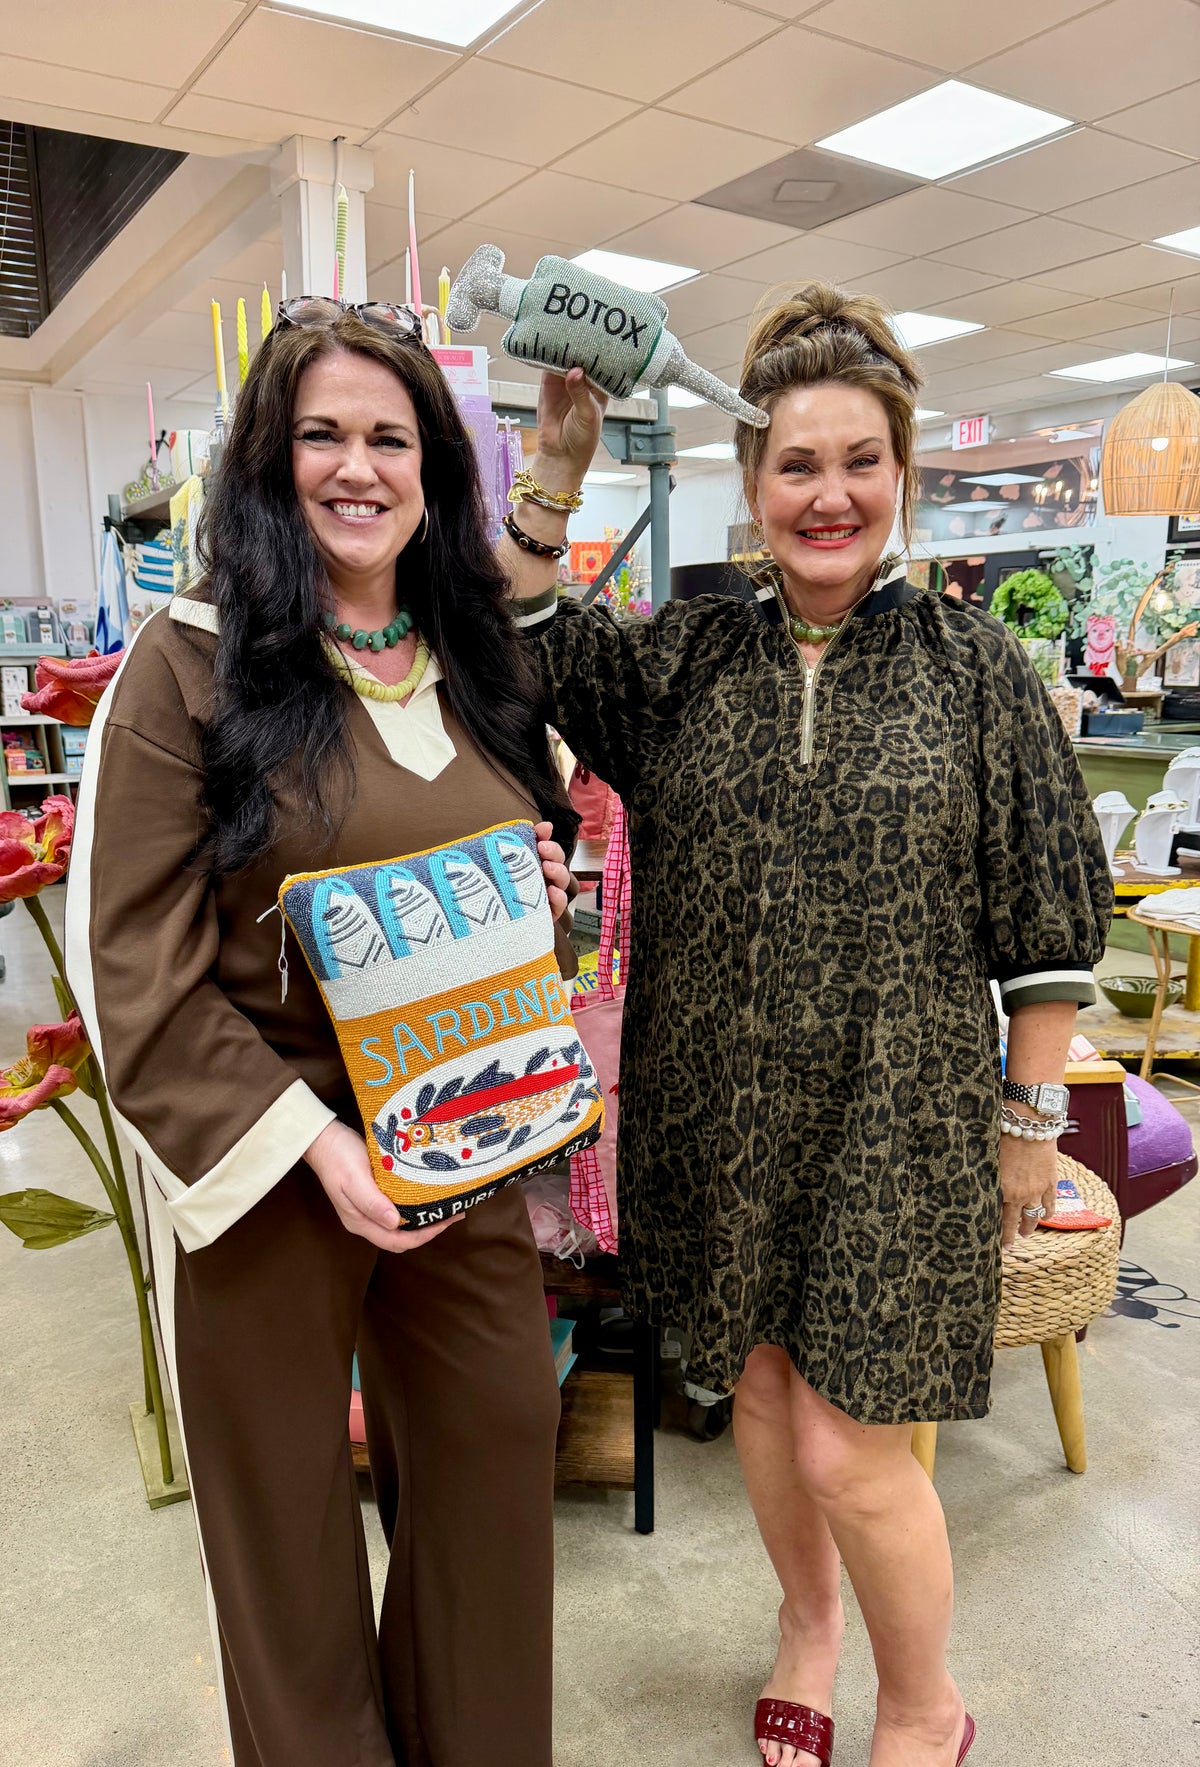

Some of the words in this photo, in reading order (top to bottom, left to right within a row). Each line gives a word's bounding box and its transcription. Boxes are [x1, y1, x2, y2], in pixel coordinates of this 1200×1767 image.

[543, 283, 649, 349] BOTOX
[959, 417, 984, 445] EXIT
[416, 1207, 444, 1226] IN
[564, 1136, 591, 1157] OIL
